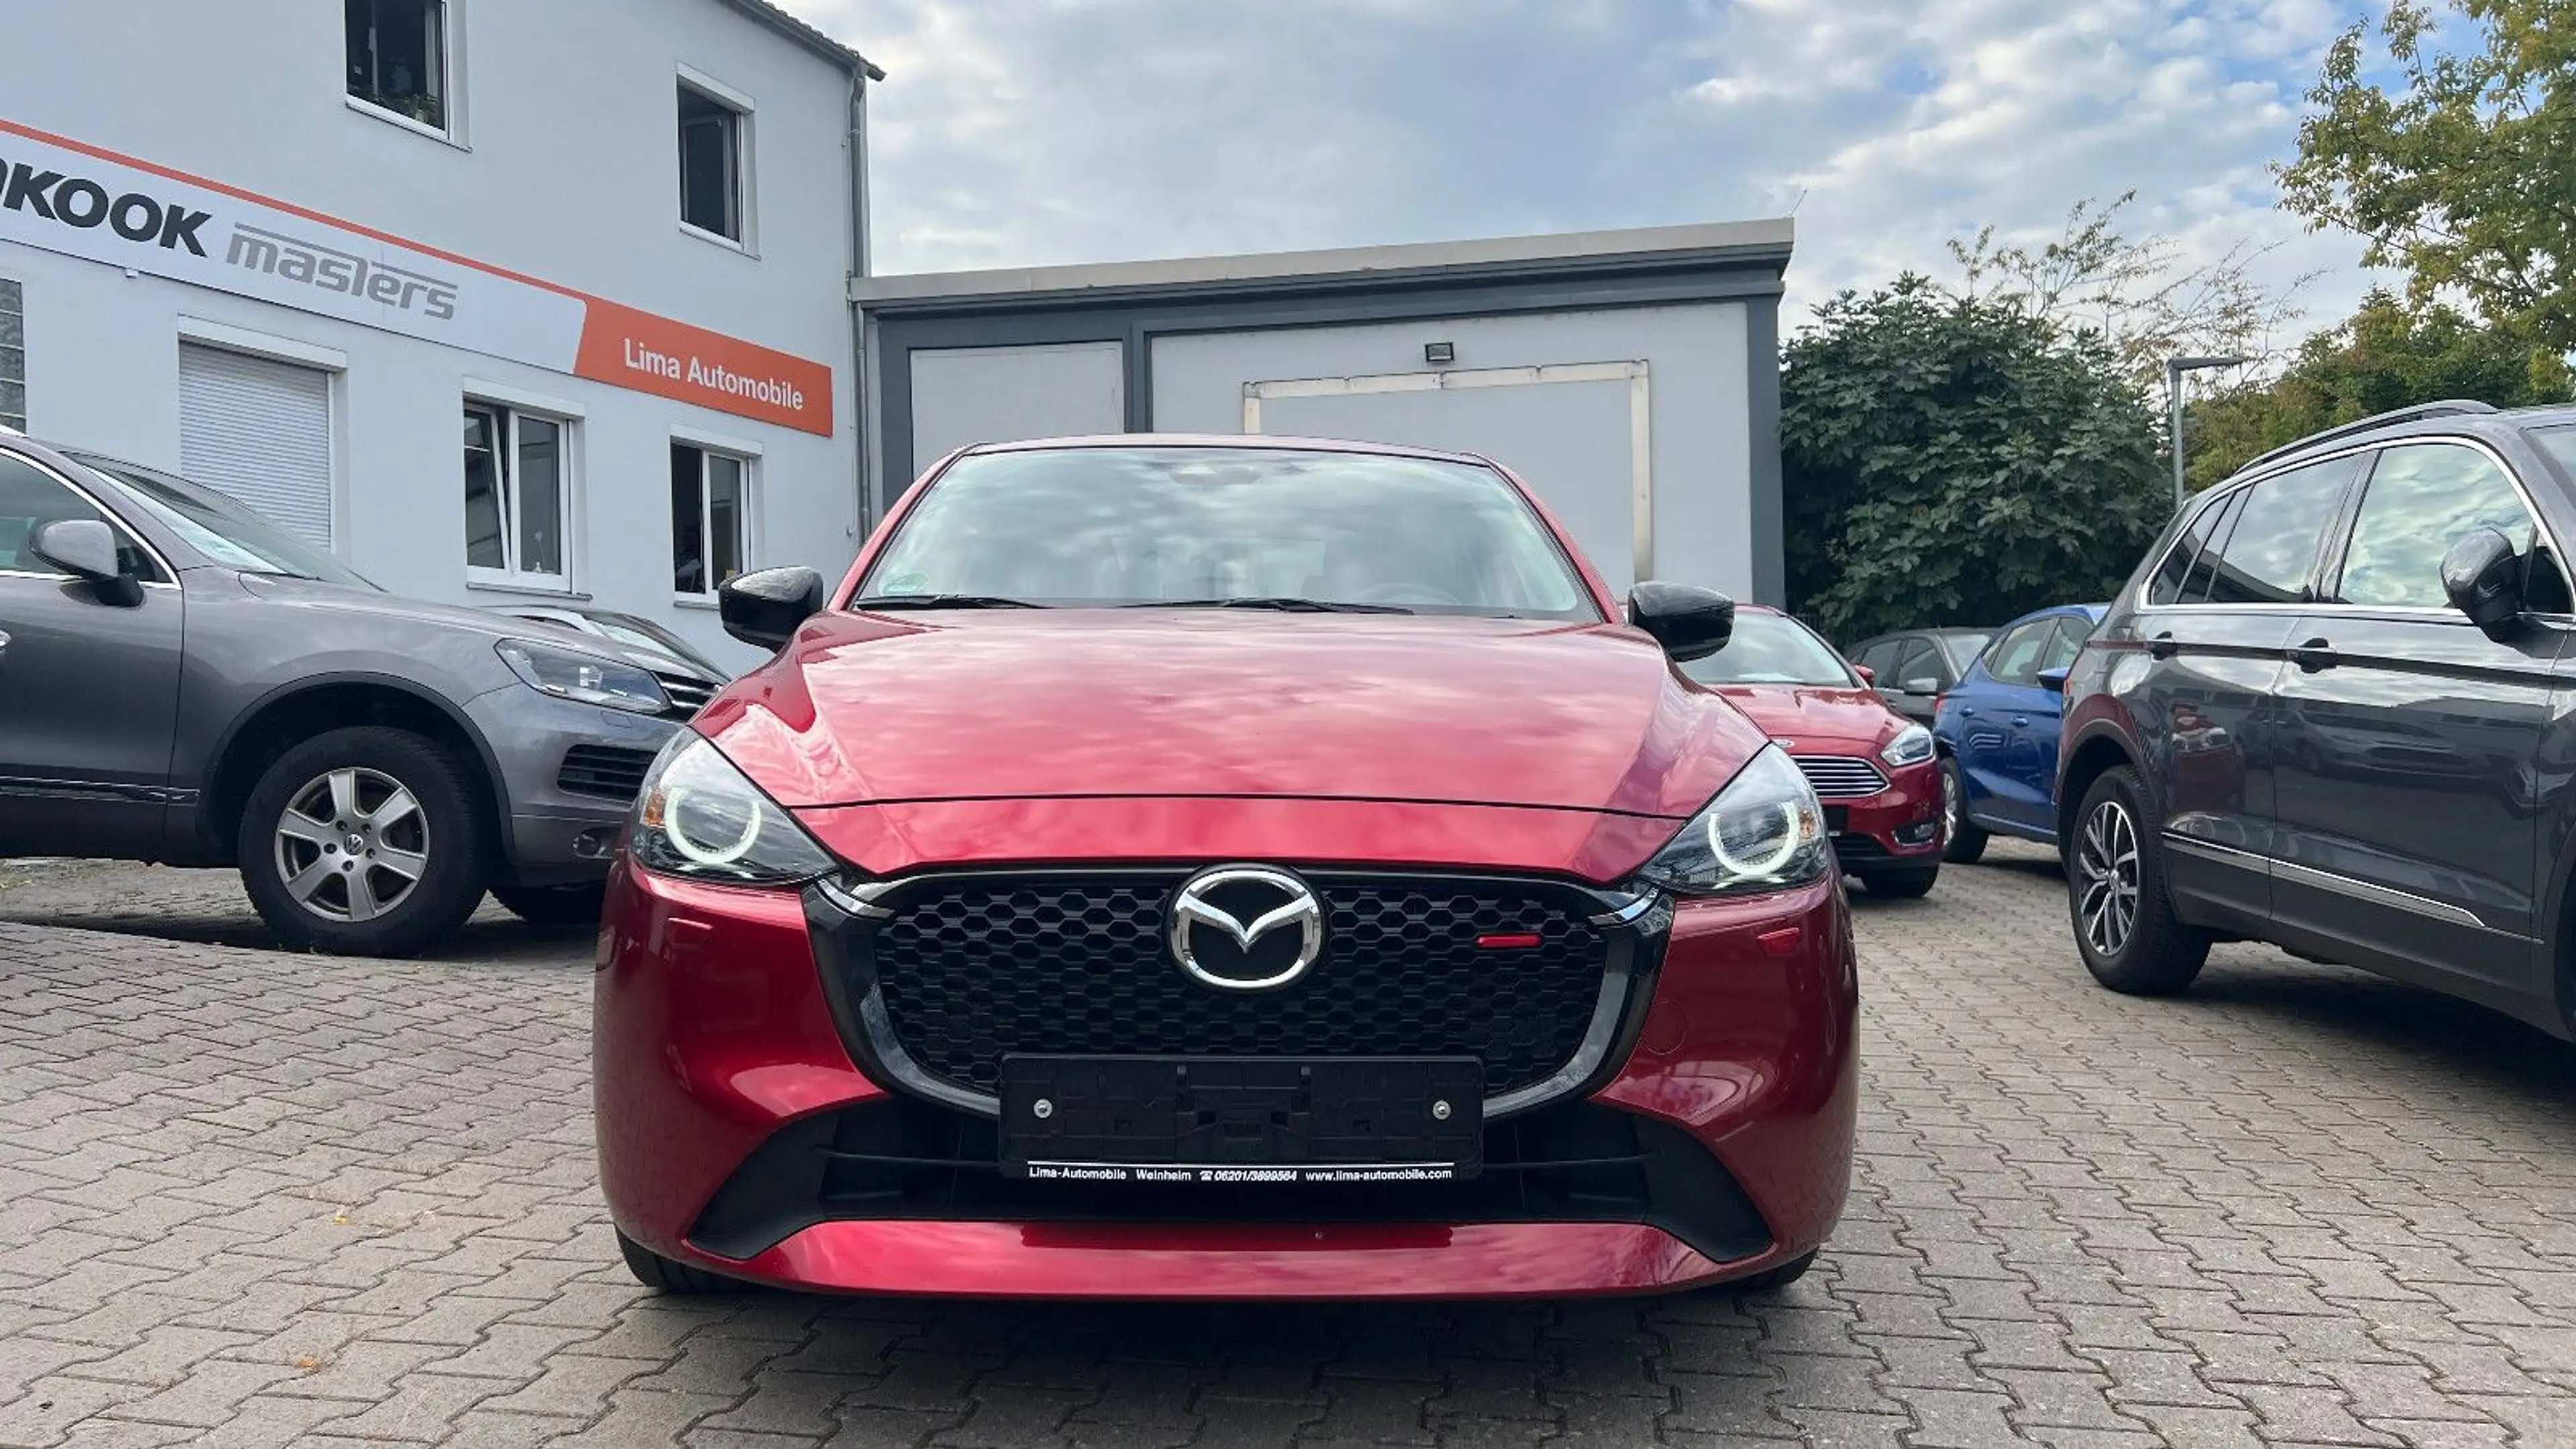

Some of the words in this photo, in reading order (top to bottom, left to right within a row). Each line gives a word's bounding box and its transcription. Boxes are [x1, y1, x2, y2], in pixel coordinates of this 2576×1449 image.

[0, 158, 213, 258] KOOK
[226, 222, 458, 320] masters
[624, 337, 680, 380] Lima
[687, 356, 803, 411] Automobile
[1029, 1166, 1127, 1180] Lima-Automobile
[1136, 1169, 1192, 1181] Weinheim
[1305, 1167, 1452, 1182] www.lima-automobile.com
